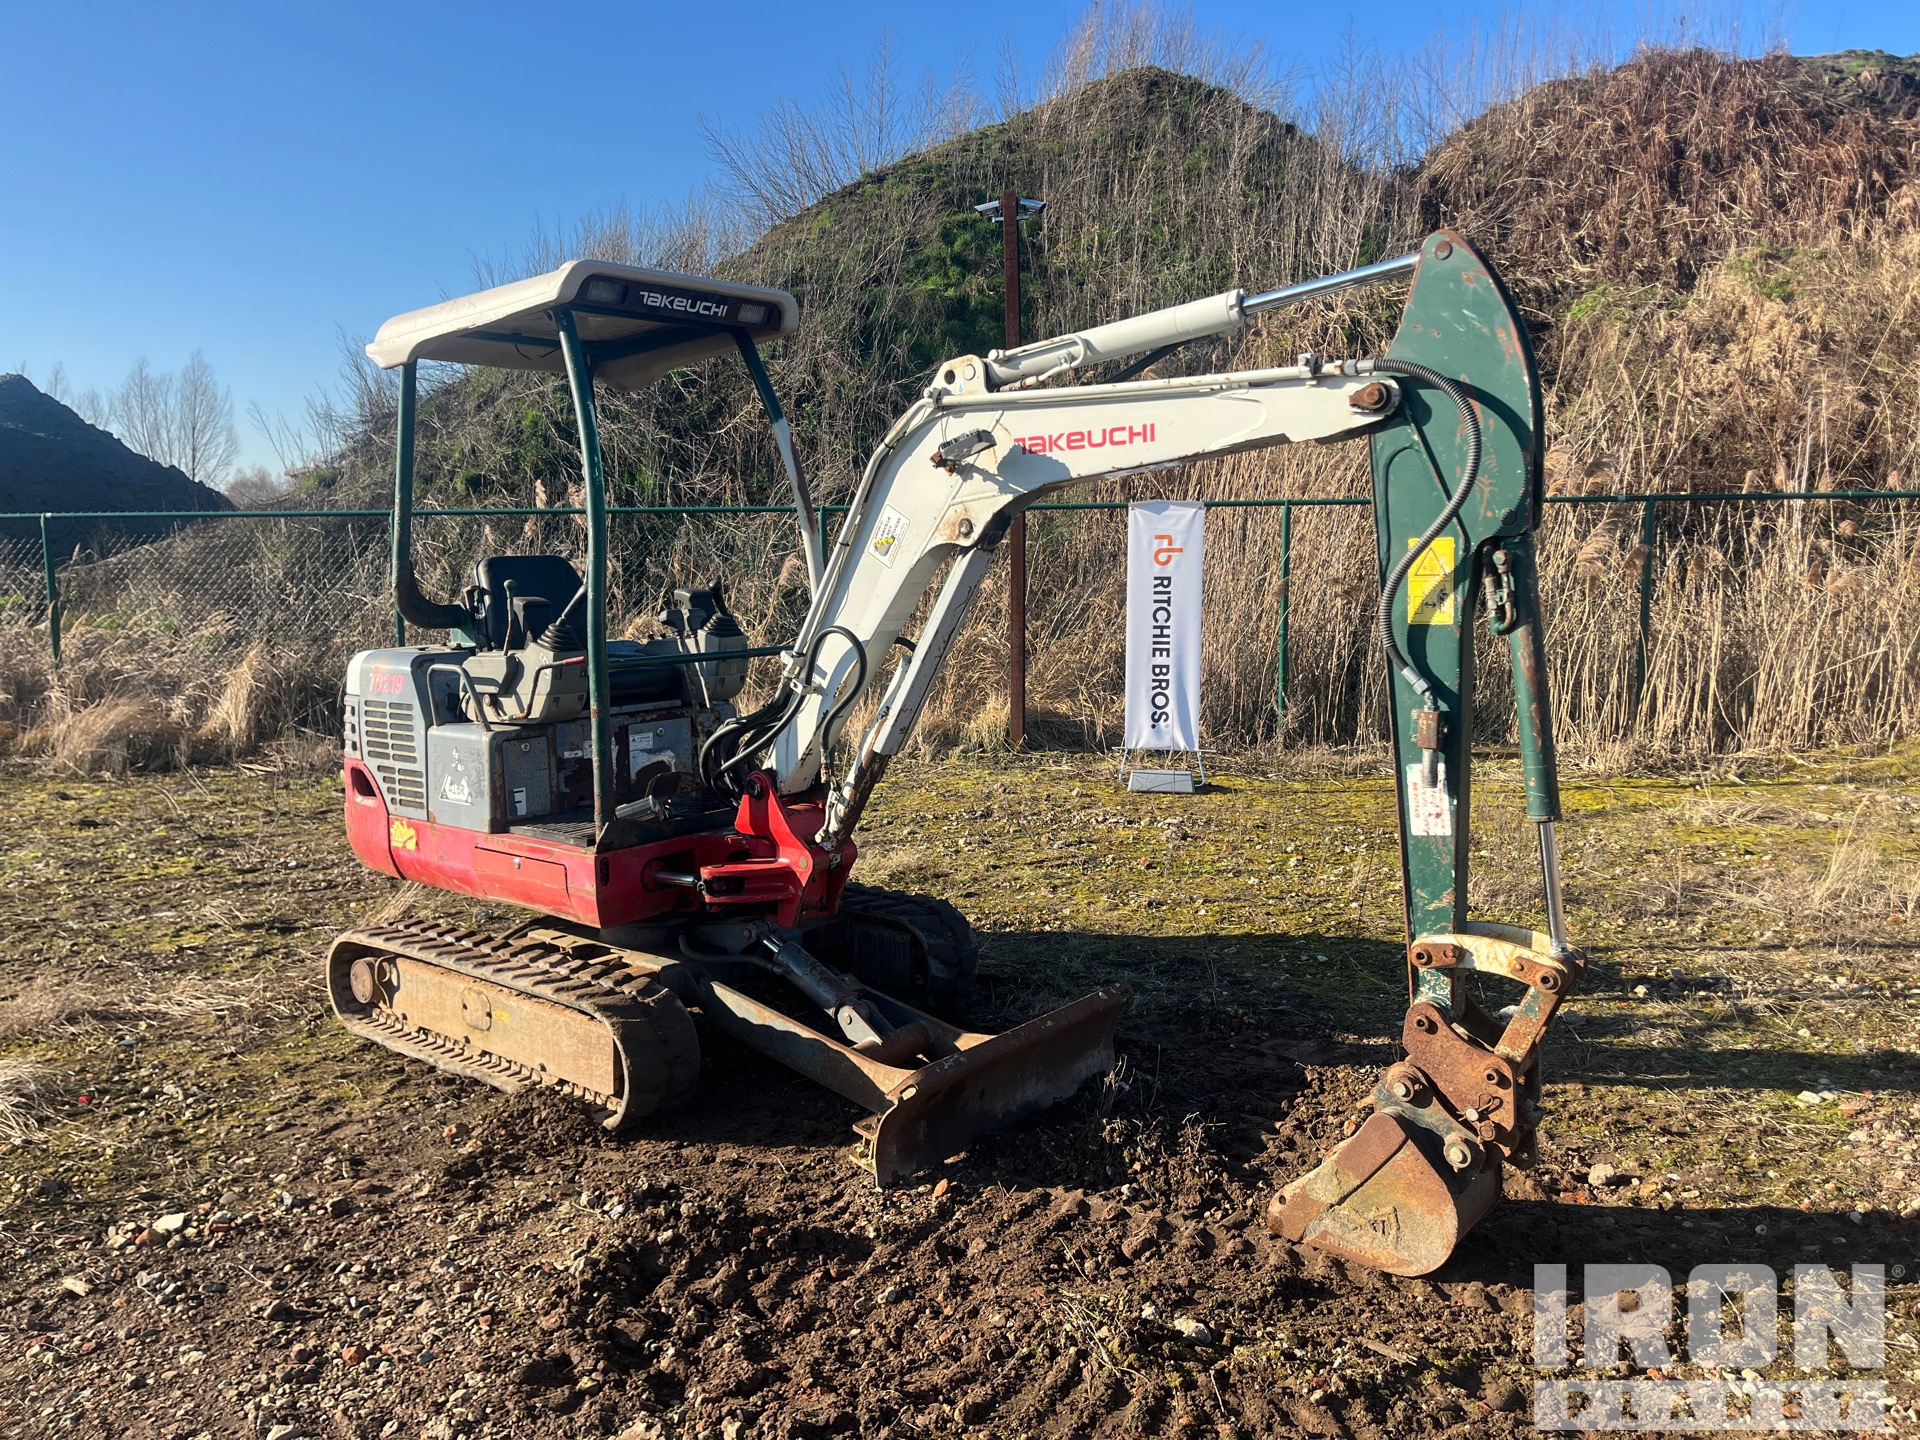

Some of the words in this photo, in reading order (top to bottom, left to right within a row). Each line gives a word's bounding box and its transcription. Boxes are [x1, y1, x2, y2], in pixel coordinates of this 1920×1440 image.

[639, 291, 728, 317] TAKEUCHI
[1013, 423, 1155, 456] TAKEUCHI
[1152, 576, 1172, 658] RITCHIE
[1150, 664, 1170, 729] BROS.
